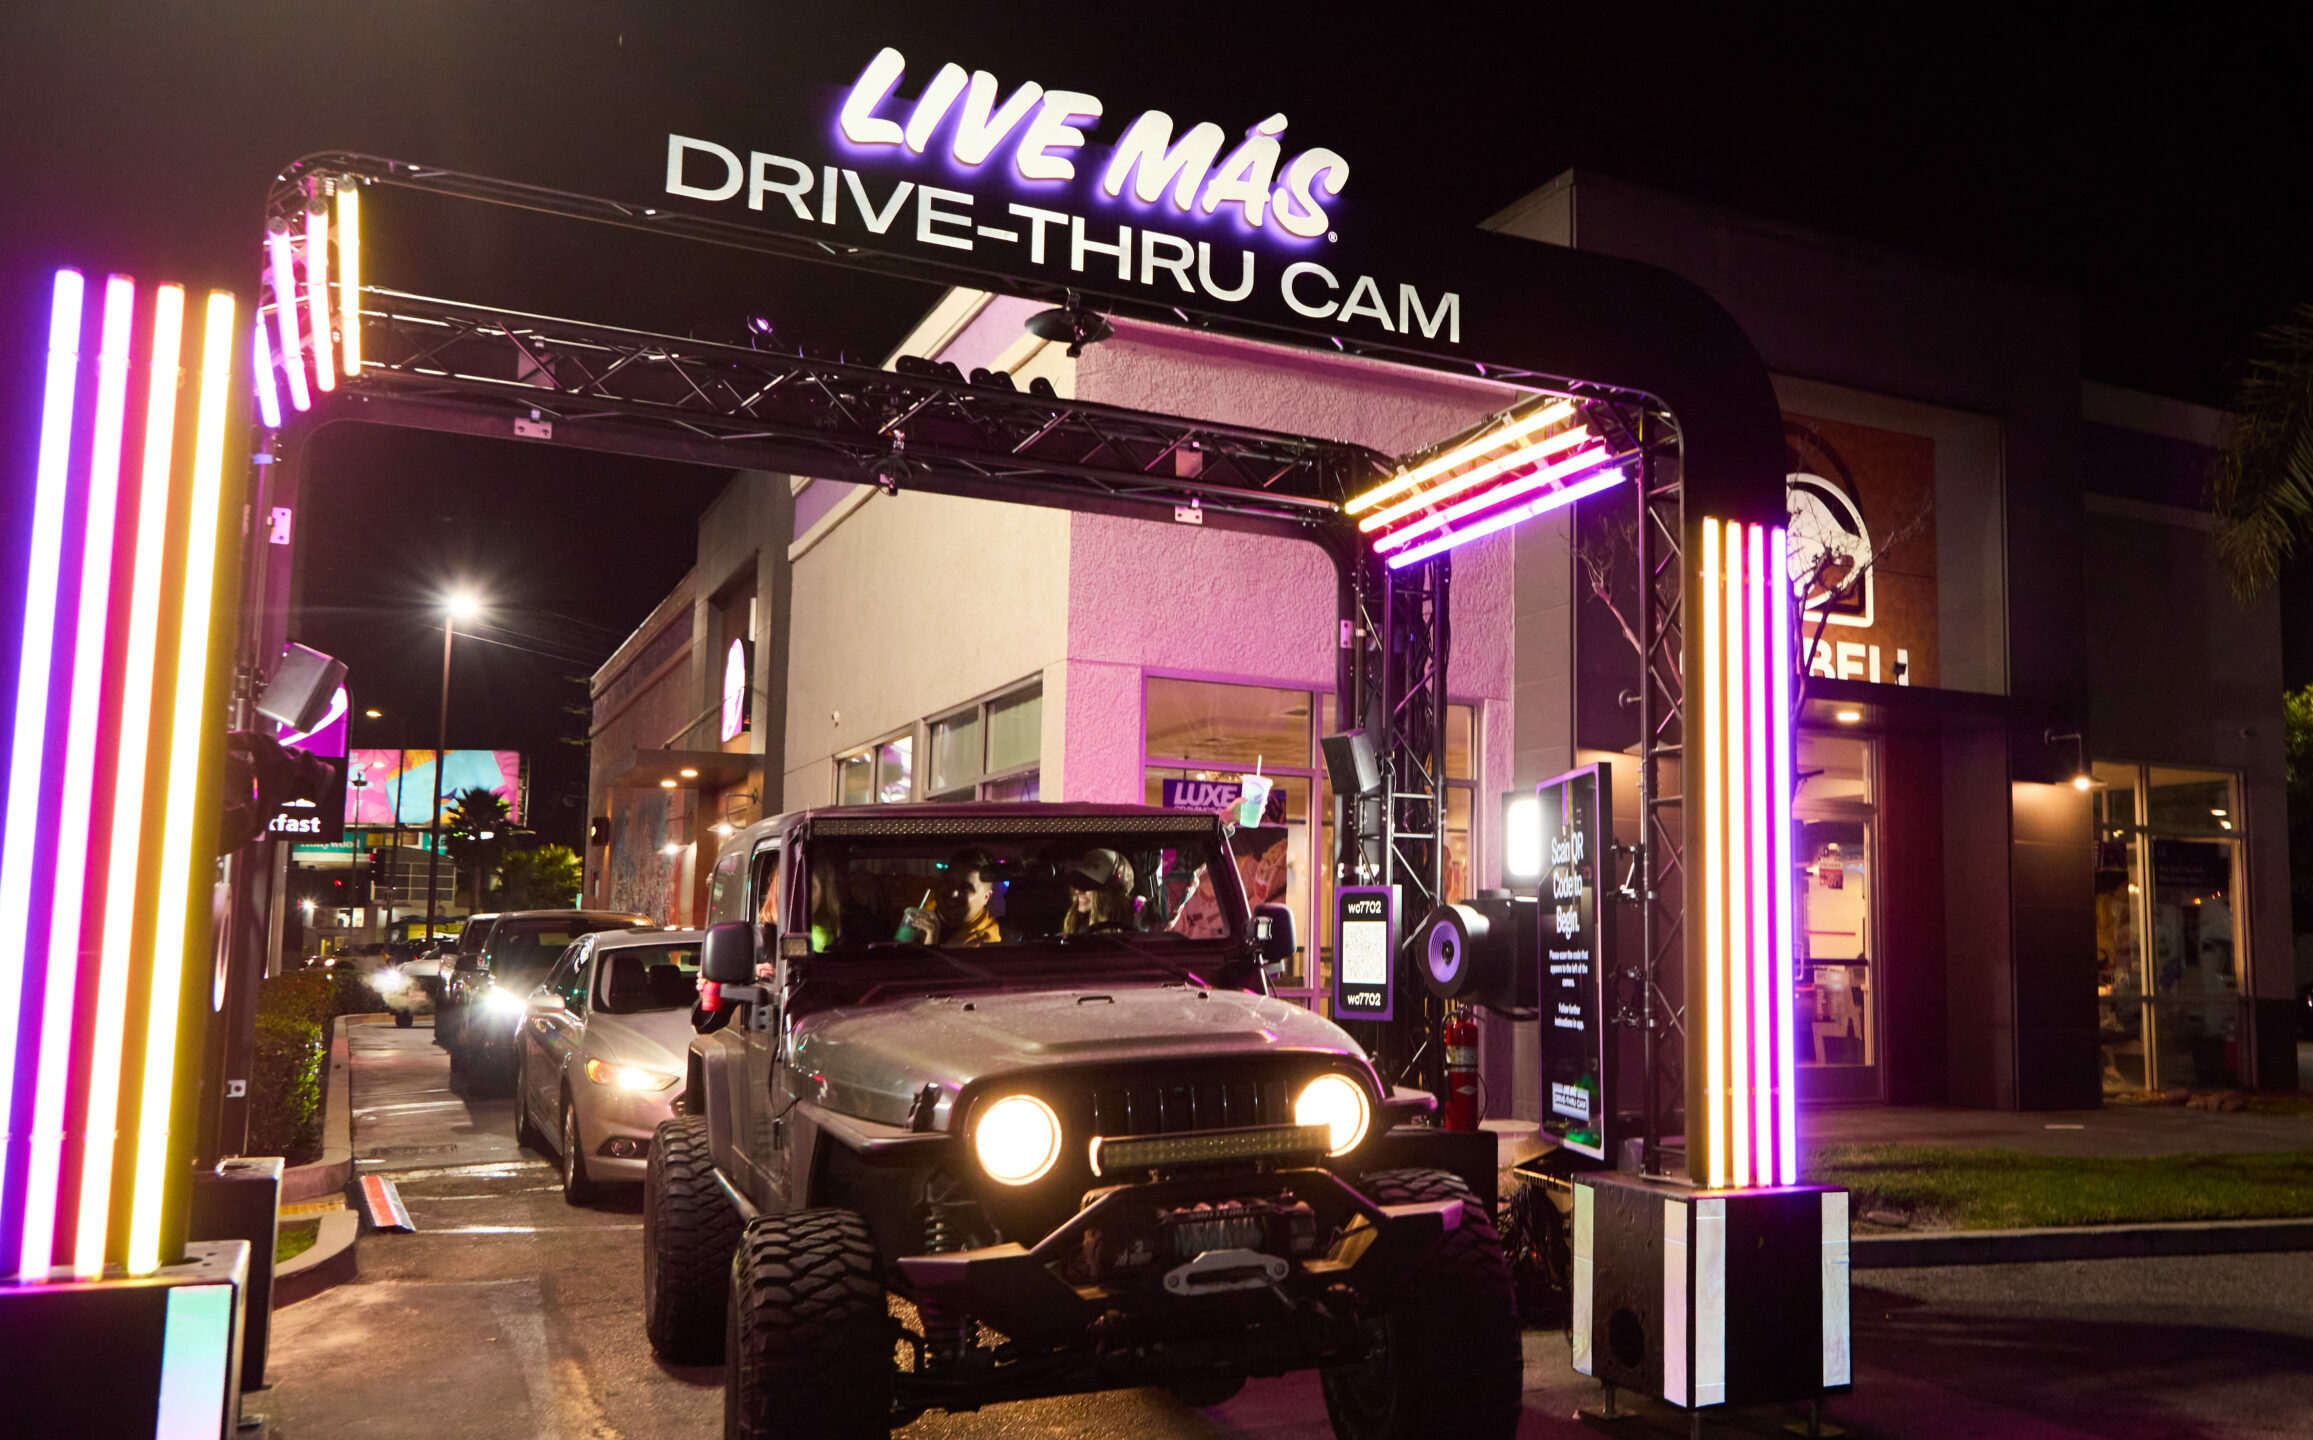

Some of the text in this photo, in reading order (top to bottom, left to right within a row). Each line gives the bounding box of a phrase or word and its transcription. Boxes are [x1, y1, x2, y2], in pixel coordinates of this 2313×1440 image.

[840, 46, 1350, 239] LIVE MÁS
[665, 133, 1461, 344] DRIVE-THRU CAM
[1173, 782, 1238, 807] LUXE
[1551, 831, 1584, 865] Scan QR
[1553, 869, 1583, 899] Code to
[1556, 905, 1581, 941] Begin.
